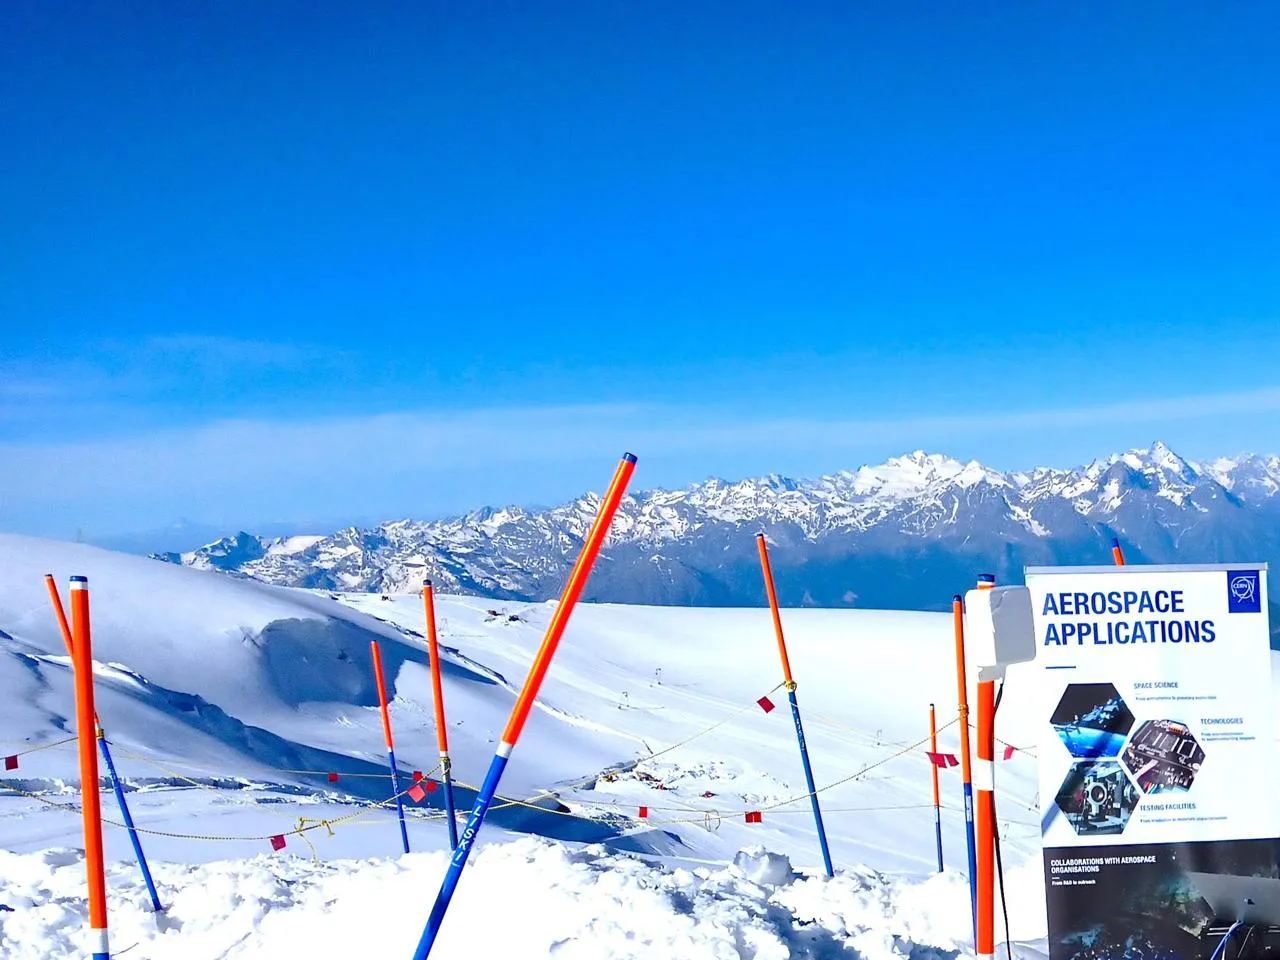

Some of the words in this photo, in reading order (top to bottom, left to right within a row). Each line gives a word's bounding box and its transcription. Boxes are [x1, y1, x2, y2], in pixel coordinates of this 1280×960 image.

[1042, 590, 1185, 616] AEROSPACE
[1044, 619, 1216, 646] APPLICATIONS
[1134, 682, 1153, 690] SPACE
[1154, 681, 1178, 689] SCIENCE
[1200, 717, 1244, 725] TECHNOLOGIES
[1165, 802, 1197, 810] FACILITIES
[455, 804, 481, 861] LISKI
[1050, 858, 1103, 866] COLLABORATIONS
[1121, 855, 1156, 864] AEROSPACE
